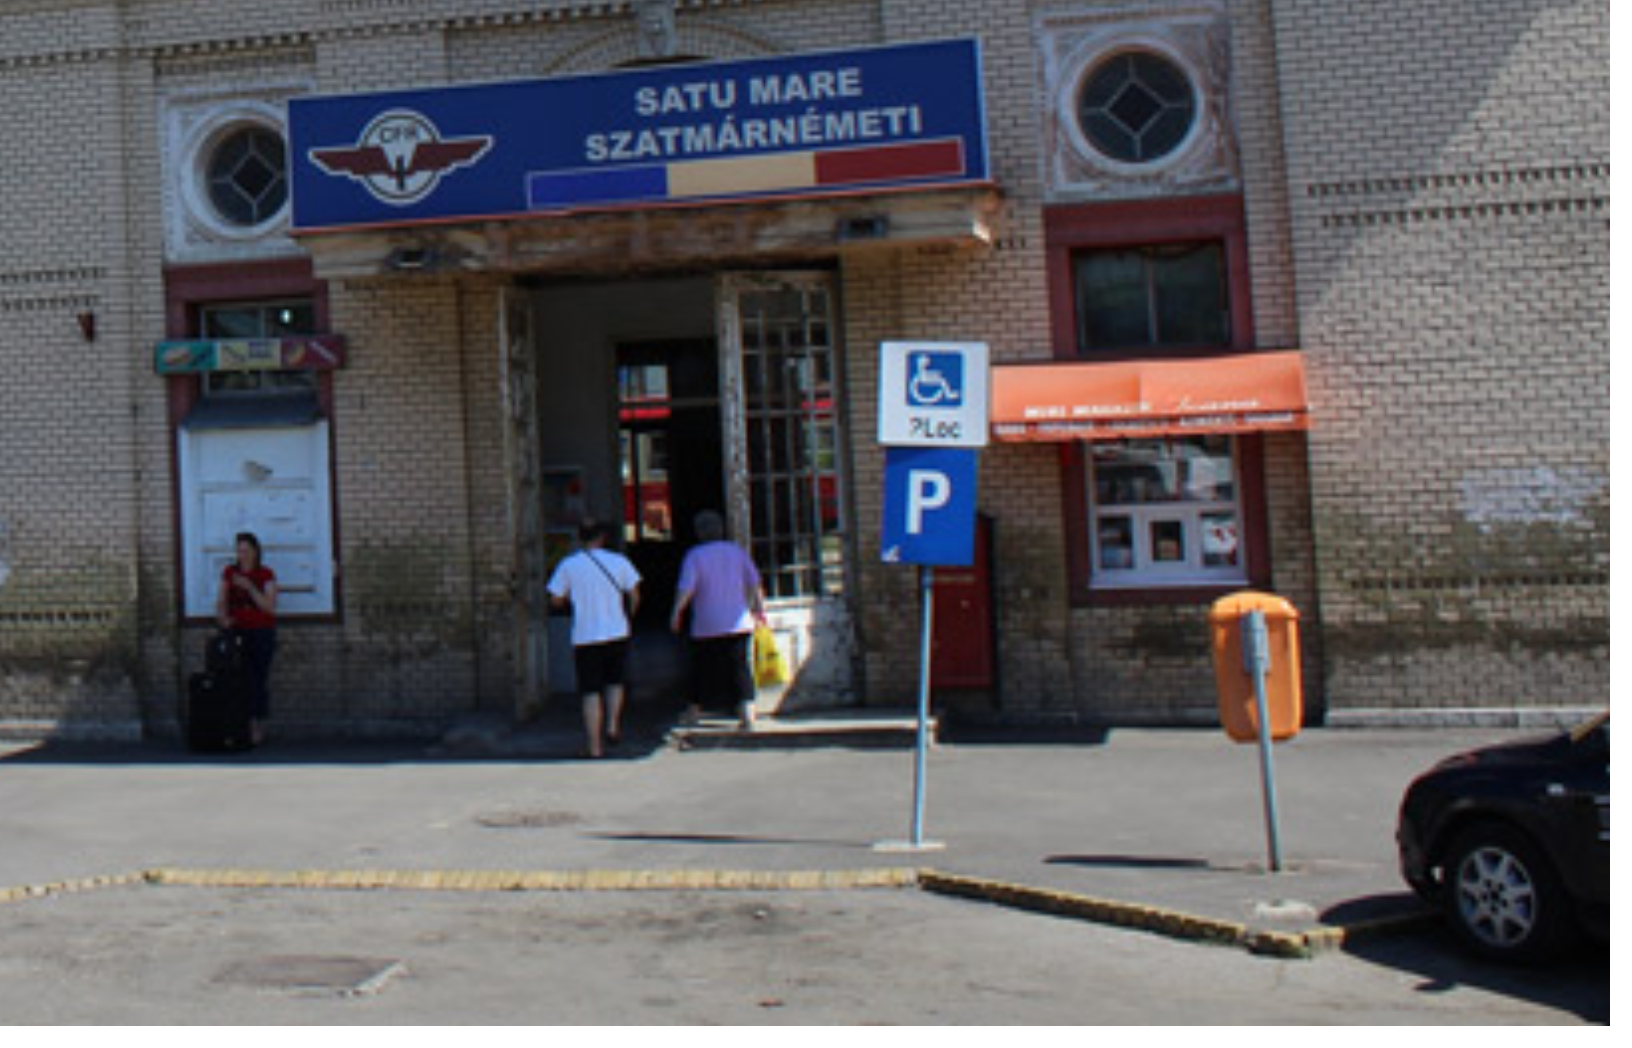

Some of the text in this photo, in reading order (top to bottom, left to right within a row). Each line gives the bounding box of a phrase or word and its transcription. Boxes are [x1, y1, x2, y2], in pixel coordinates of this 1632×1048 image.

[634, 66, 863, 116] SATU MARE
[584, 104, 923, 161] SZATMÁRNÉMETI
[905, 468, 952, 535] P
